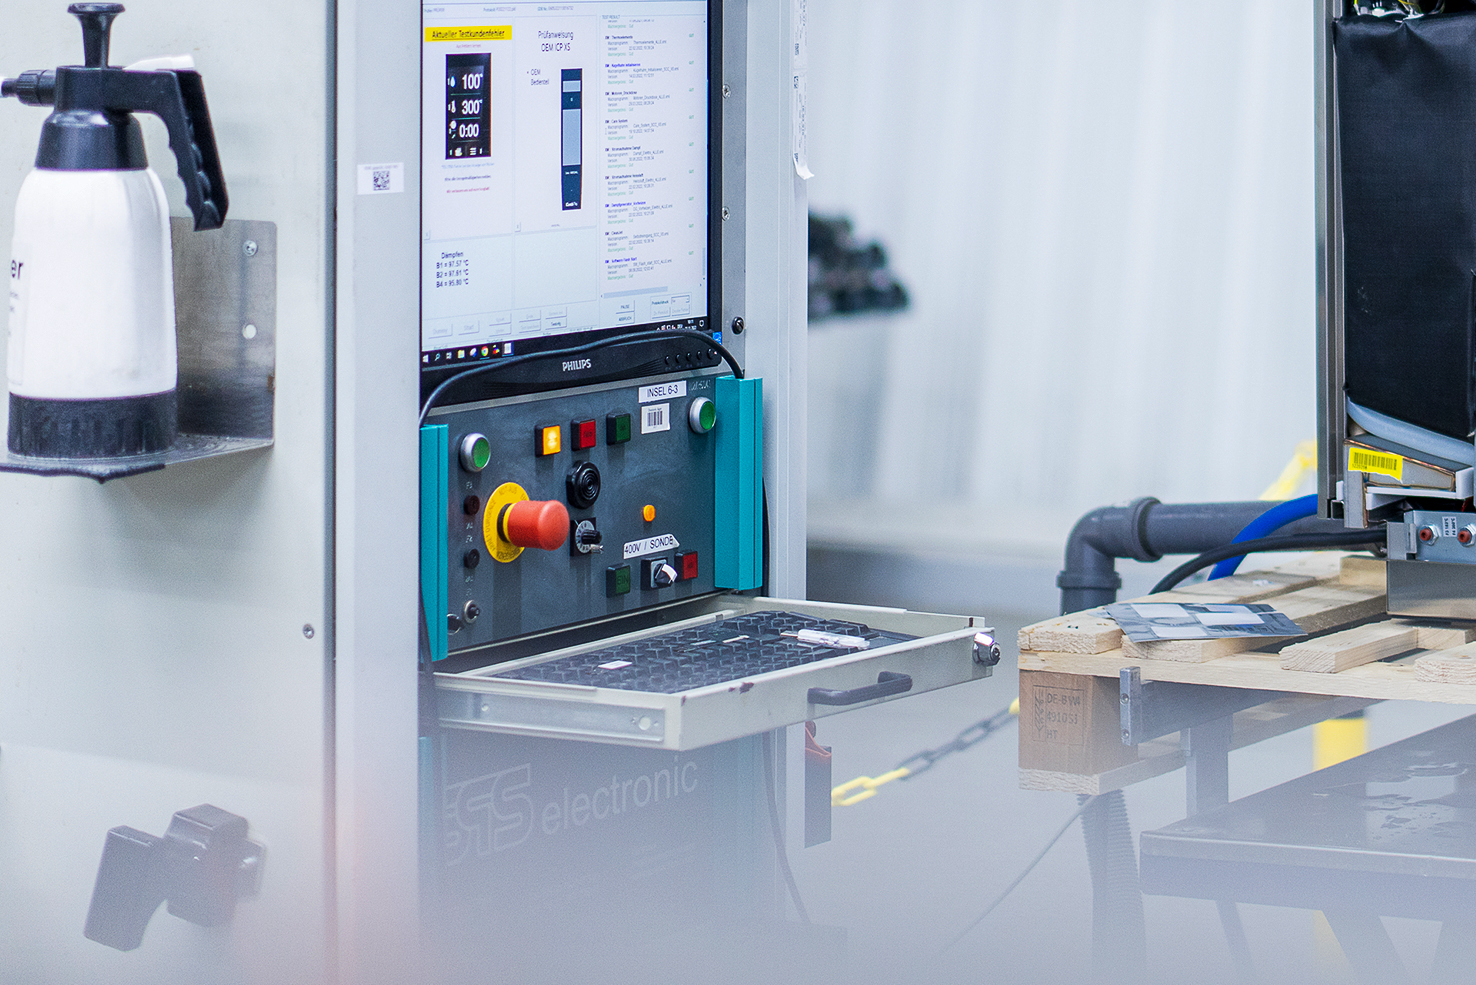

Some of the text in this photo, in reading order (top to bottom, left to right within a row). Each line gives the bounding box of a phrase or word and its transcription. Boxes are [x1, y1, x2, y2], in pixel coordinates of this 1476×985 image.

[538, 30, 574, 41] Prüfanweisung
[541, 43, 554, 53] OEM
[458, 123, 480, 138] 0:00
[436, 271, 443, 279] B2
[436, 280, 443, 288] B4
[562, 358, 592, 372] PHILIPS
[646, 386, 667, 398] INSEL
[667, 384, 679, 395] 6-3
[541, 754, 699, 836] electronic
